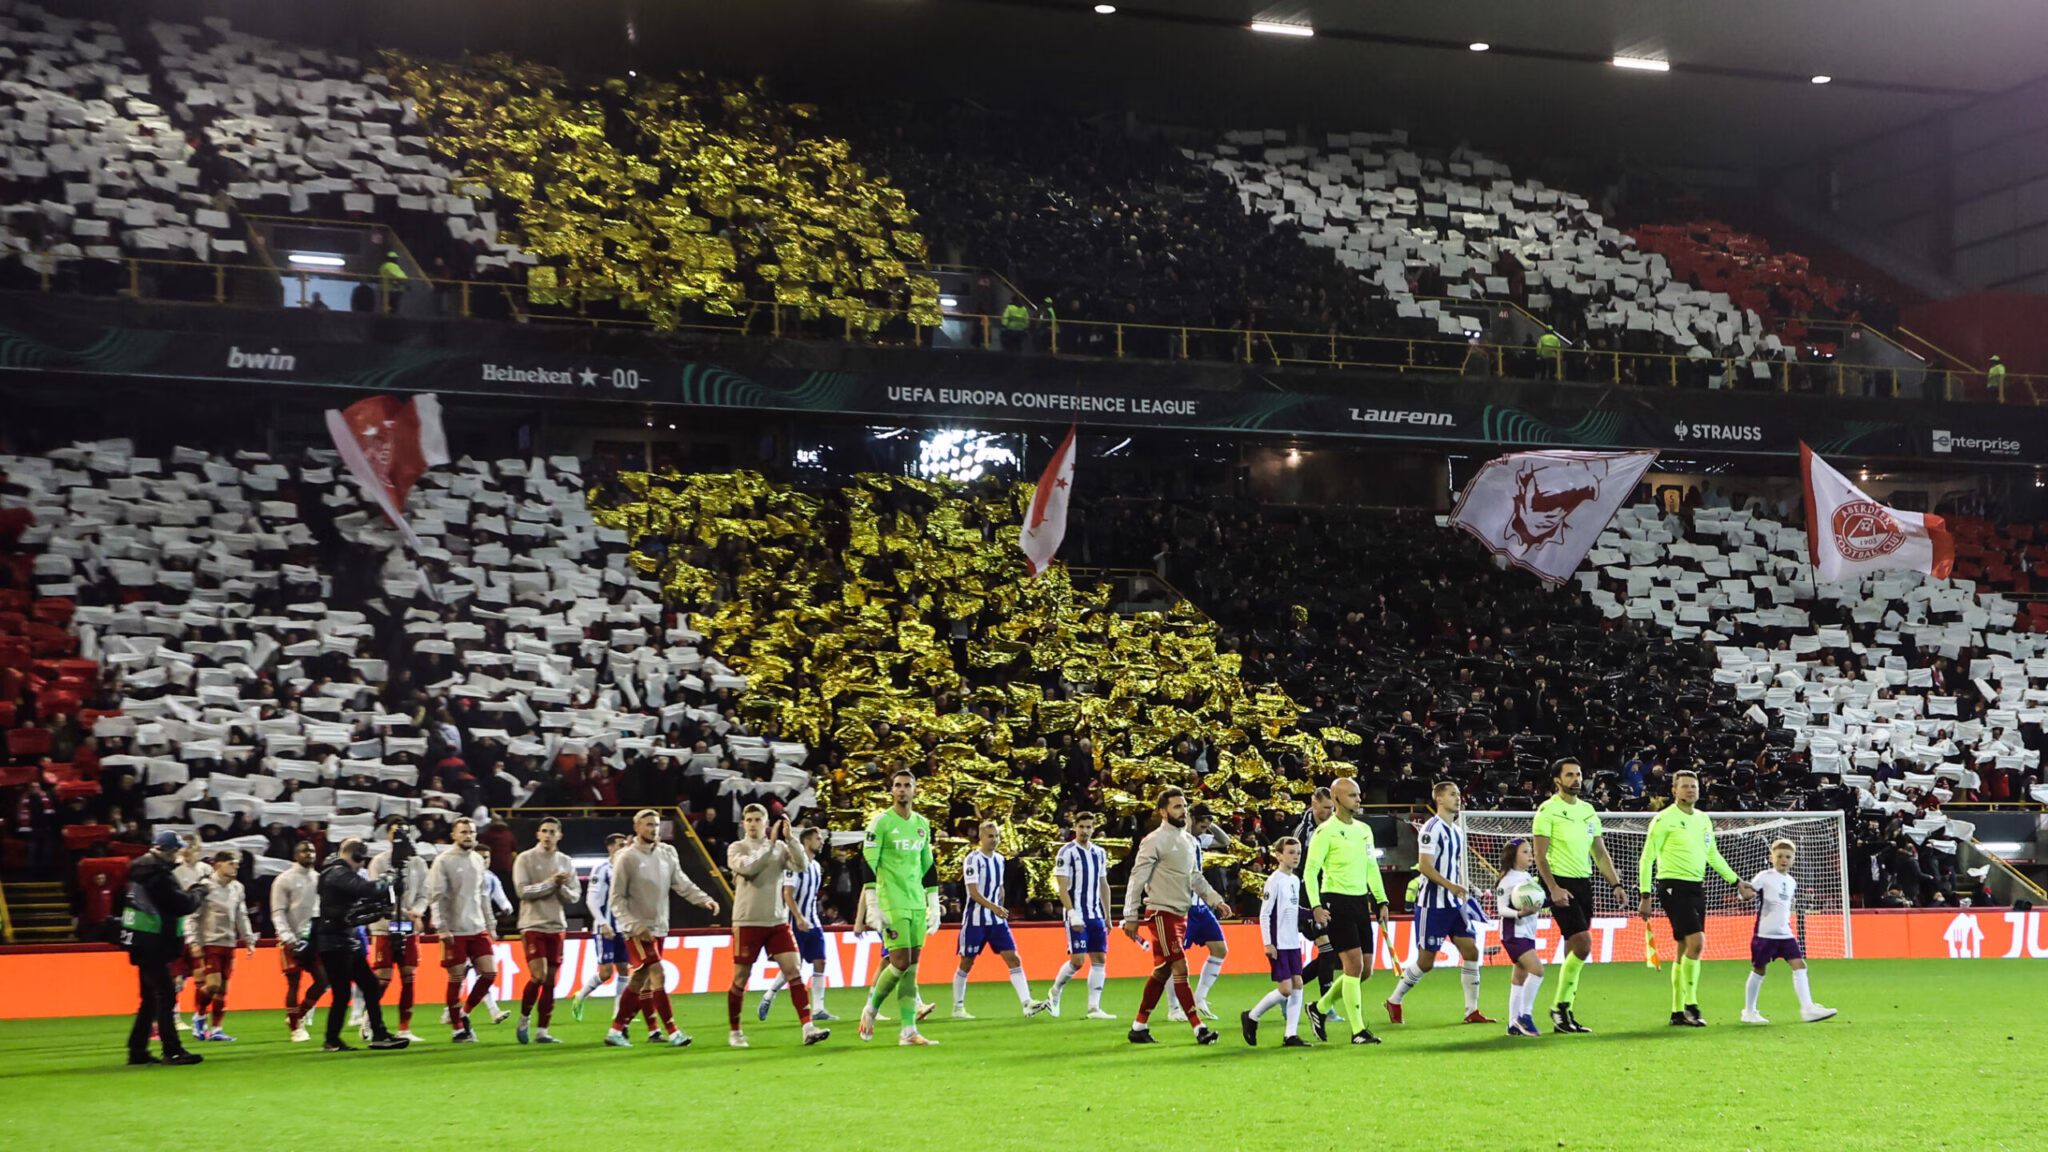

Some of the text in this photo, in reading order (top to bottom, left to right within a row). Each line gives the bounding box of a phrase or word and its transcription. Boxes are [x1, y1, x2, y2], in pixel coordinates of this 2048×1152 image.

[226, 346, 296, 371] bwin
[482, 363, 573, 385] Heineken
[888, 386, 1197, 415] UEFA EUROPA CONFERENCE LEAGUE
[1692, 424, 1762, 441] STRAUSS
[1937, 435, 2020, 452] enterprise
[1860, 537, 1878, 546] 1903
